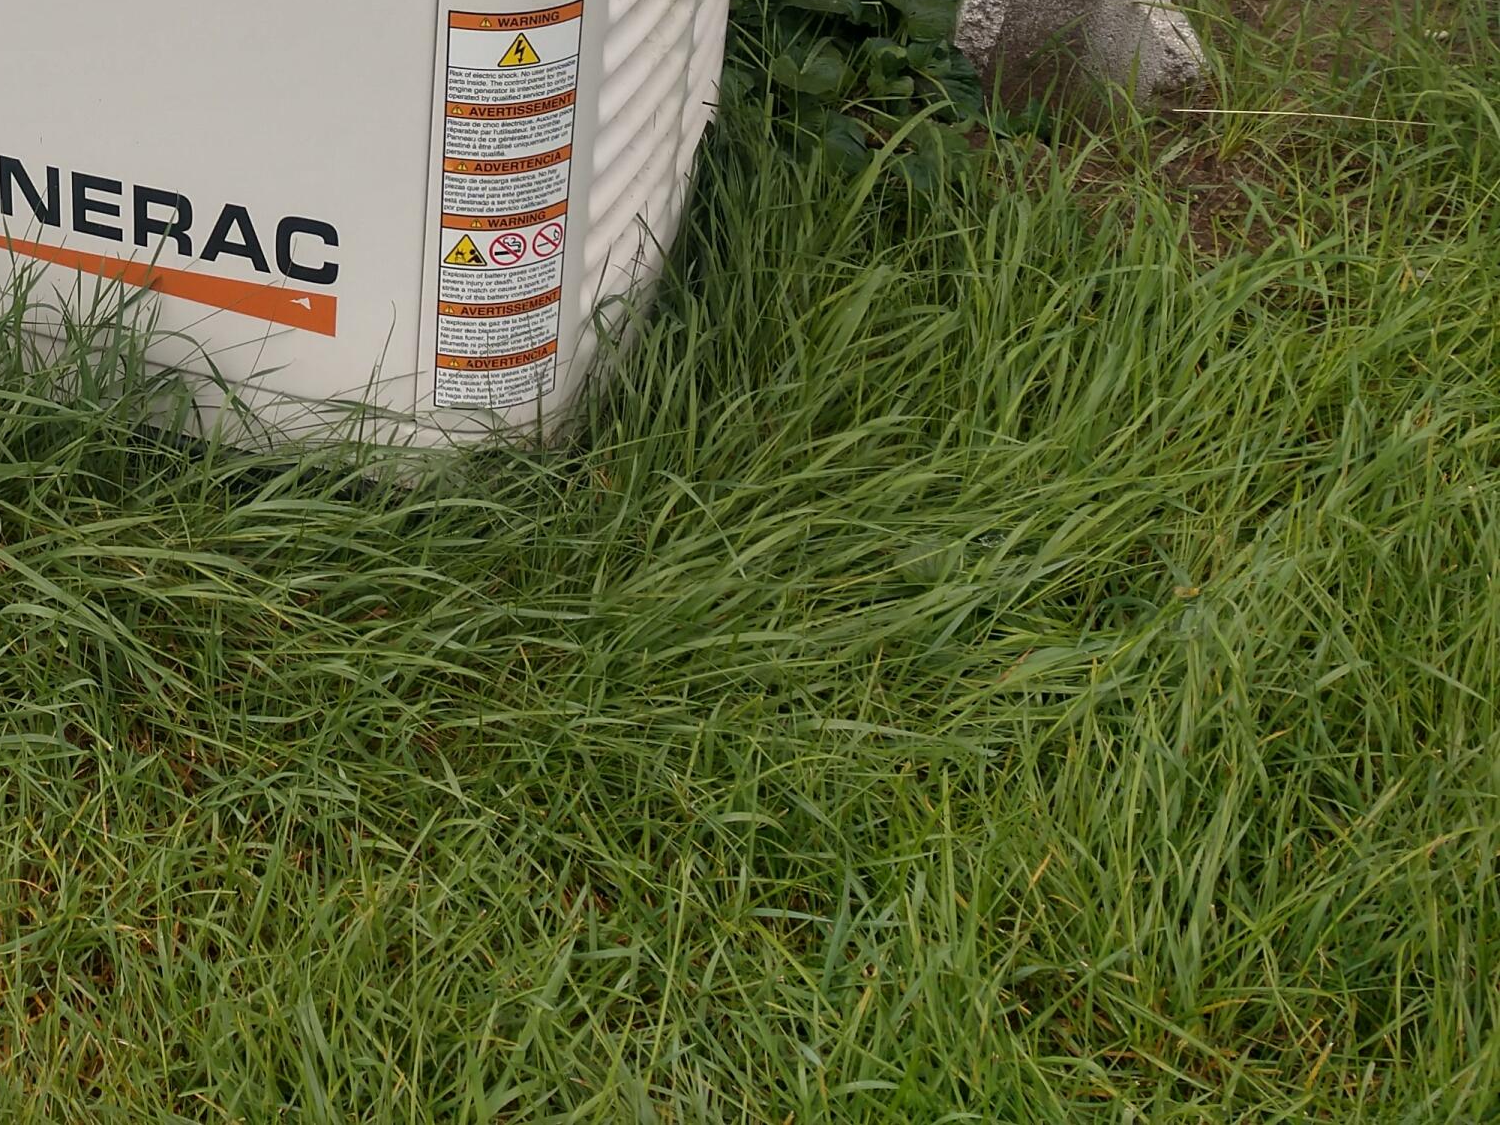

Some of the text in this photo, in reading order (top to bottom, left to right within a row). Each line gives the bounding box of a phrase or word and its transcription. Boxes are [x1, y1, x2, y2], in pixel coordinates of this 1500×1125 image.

[498, 11, 559, 27] WARNING
[470, 93, 573, 116] AVERTISSEMENT
[474, 152, 562, 172] ADVERTENCIA
[488, 211, 546, 228] WARNING
[461, 291, 557, 316] AVERTISSEMENT
[466, 348, 548, 368] ADVERTENCIA
